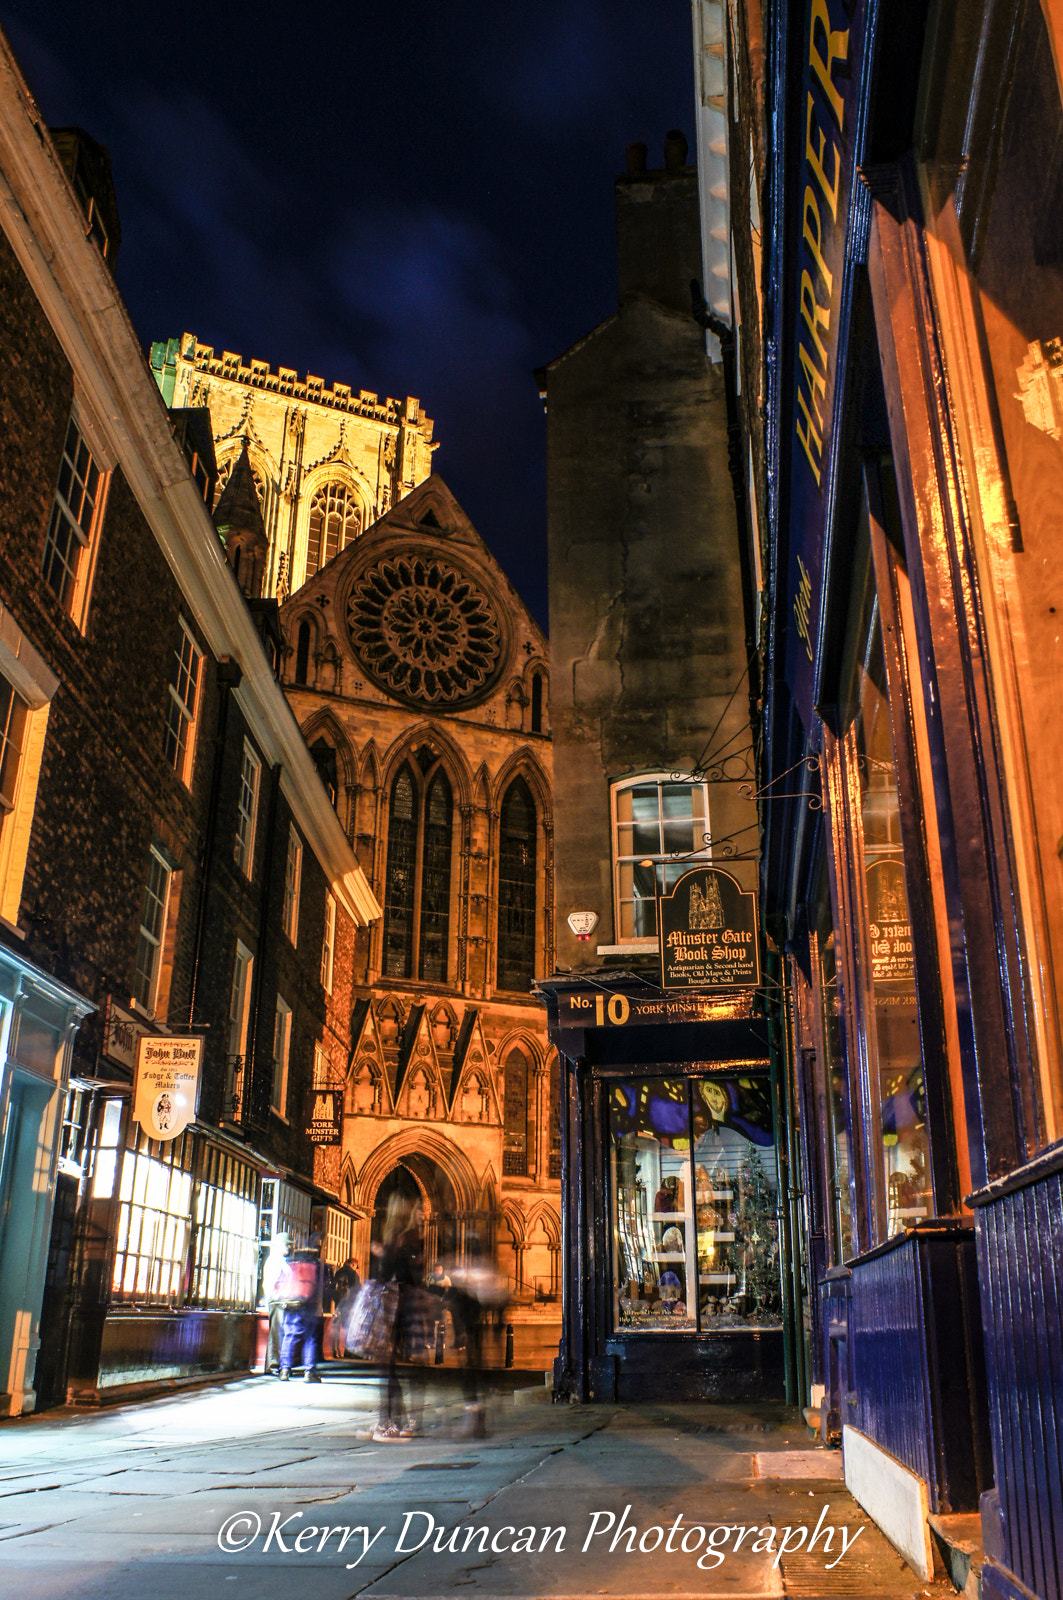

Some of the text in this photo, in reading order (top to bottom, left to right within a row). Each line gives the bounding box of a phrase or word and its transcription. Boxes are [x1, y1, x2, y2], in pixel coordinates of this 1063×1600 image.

[666, 929, 752, 947] Minster Gate
[674, 945, 746, 963] Book Shop
[667, 964, 704, 972] Antiquarian
[688, 977, 710, 985] Bought
[570, 993, 630, 1026] No. 10
[636, 1004, 664, 1014] YORK
[145, 1047, 196, 1060] John Bull
[142, 1072, 164, 1080] Fudge
[155, 1081, 180, 1089] Makers
